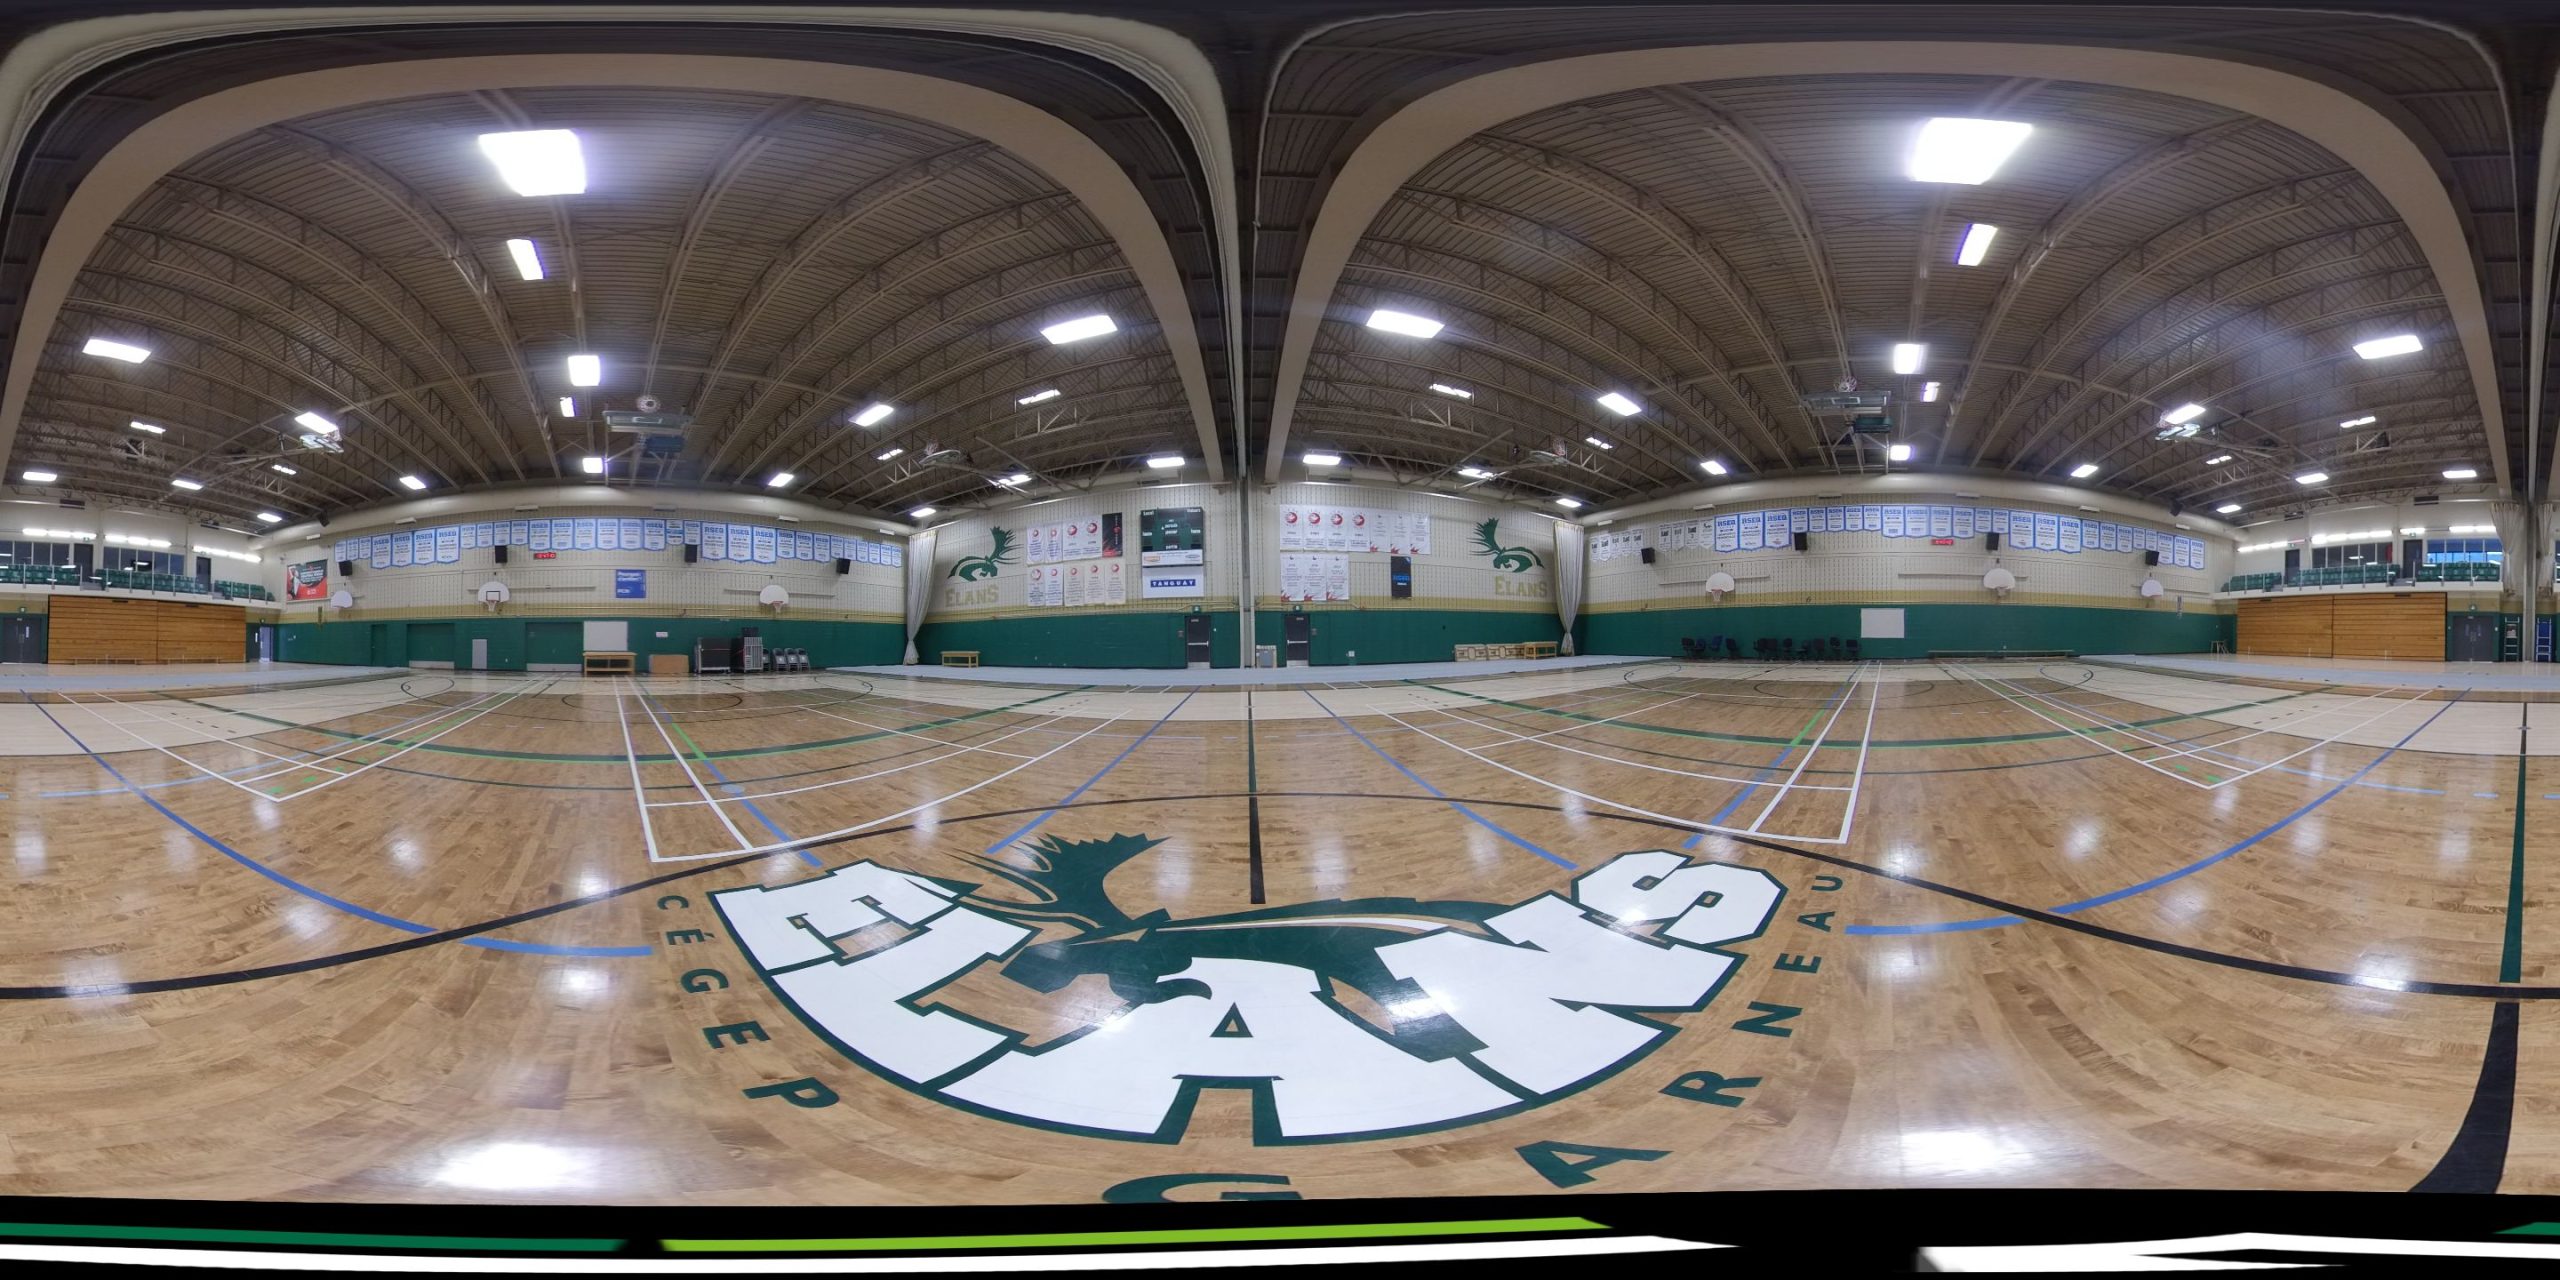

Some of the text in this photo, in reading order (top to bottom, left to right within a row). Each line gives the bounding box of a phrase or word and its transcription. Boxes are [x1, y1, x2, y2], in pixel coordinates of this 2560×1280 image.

[945, 584, 999, 607] ELANS
[1495, 576, 1548, 598] ELANS
[657, 894, 840, 1109] CÉGEP
[707, 849, 1789, 1145] ELANS
